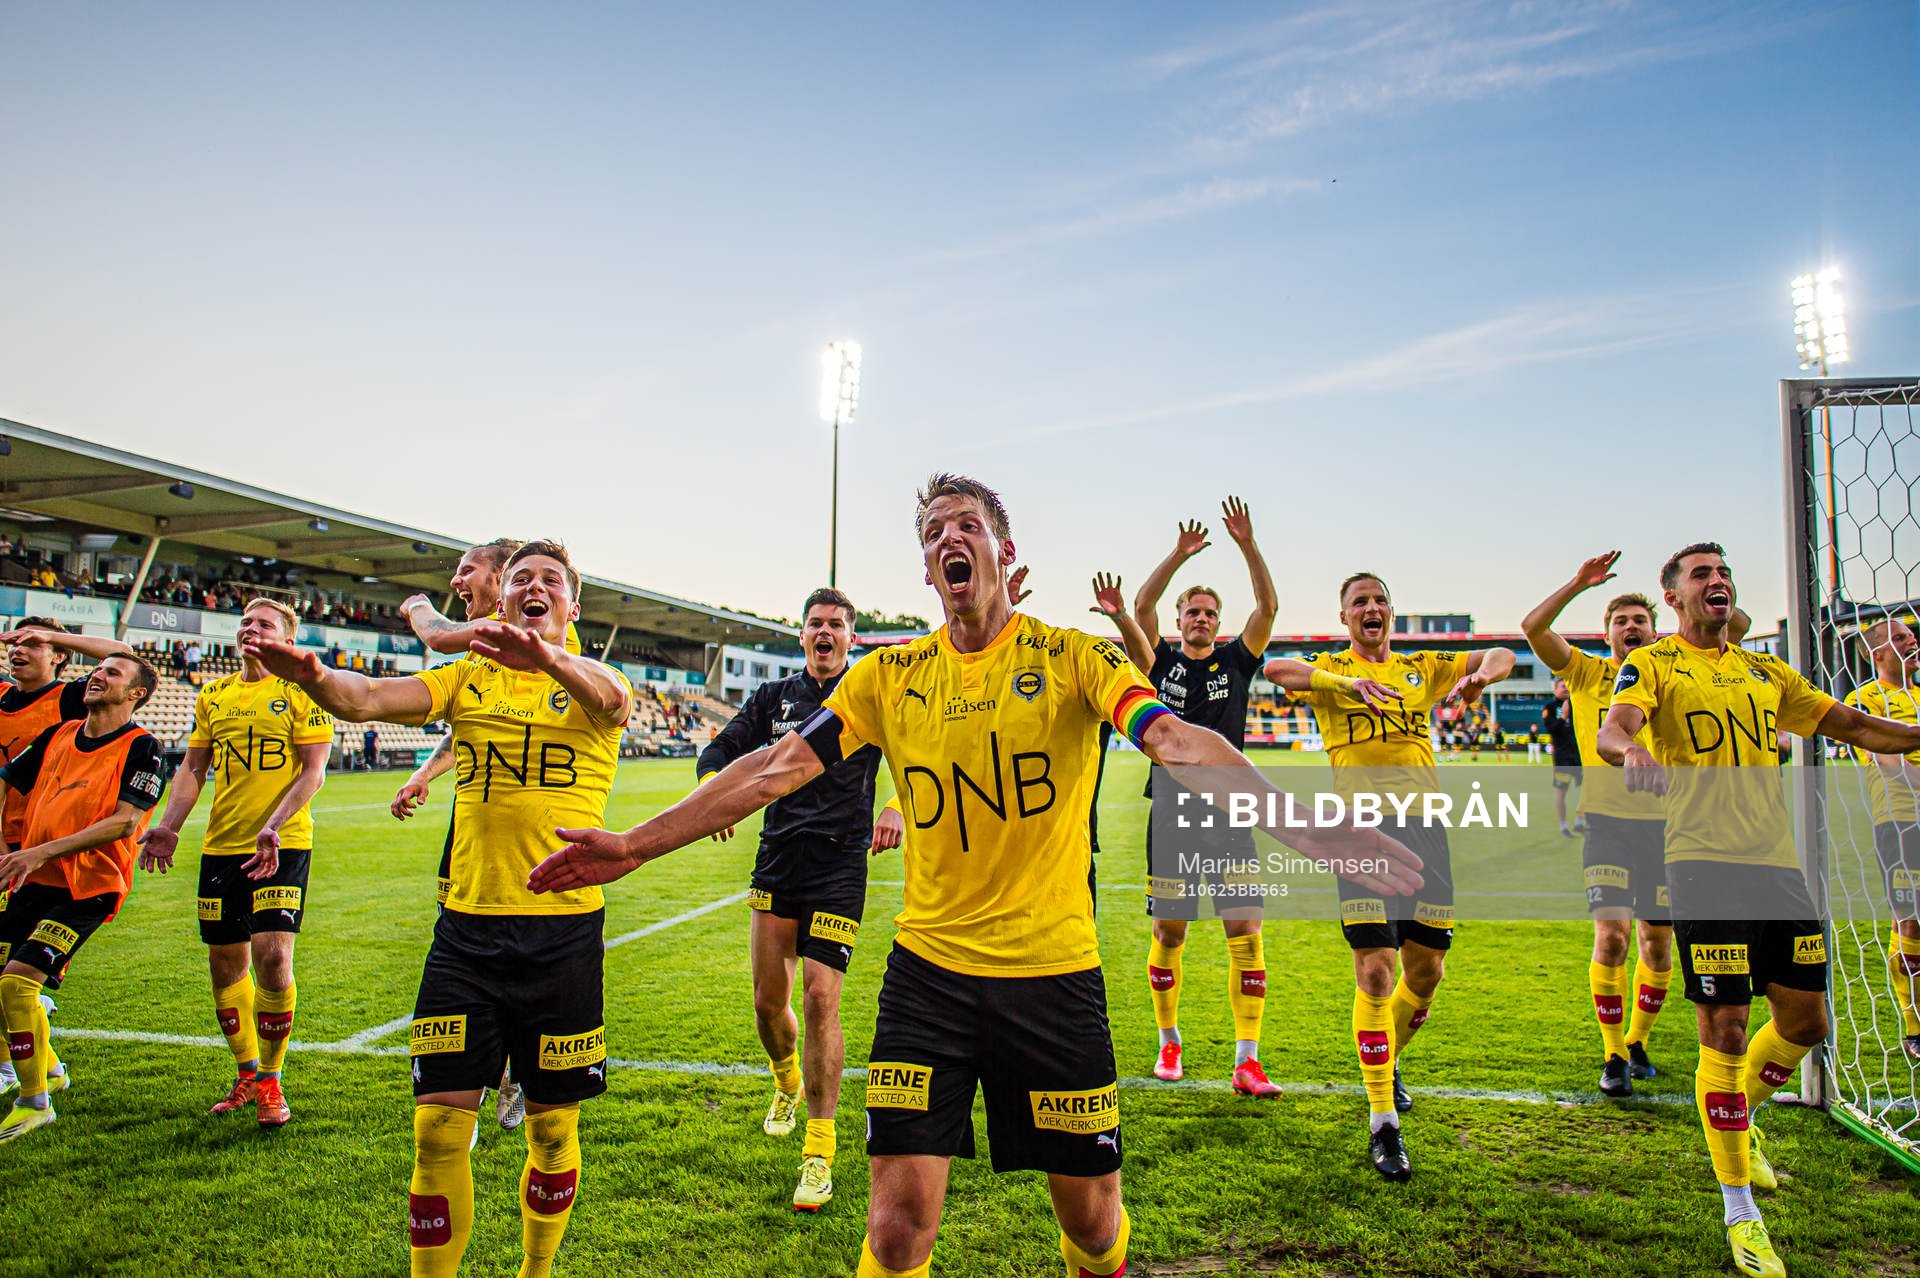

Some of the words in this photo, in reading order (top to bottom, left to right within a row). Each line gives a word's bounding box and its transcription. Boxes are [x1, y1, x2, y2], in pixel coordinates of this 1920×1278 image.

[152, 609, 177, 629] DNB
[1207, 674, 1228, 692] DNB
[1208, 689, 1229, 701] SATS
[1347, 701, 1428, 744] DNB
[211, 725, 286, 785] DNB
[457, 725, 578, 803] DNB
[904, 731, 1056, 852] DNB
[1798, 938, 1824, 952] ÅKR
[1701, 976, 1717, 997] 5
[412, 1021, 462, 1039] RENE
[447, 1040, 461, 1049] AS
[868, 1069, 926, 1088] RENE
[868, 1092, 907, 1104] ERKSTED
[909, 1095, 924, 1106] AS
[530, 1183, 573, 1200] rb.no
[410, 1213, 445, 1229] b.no
